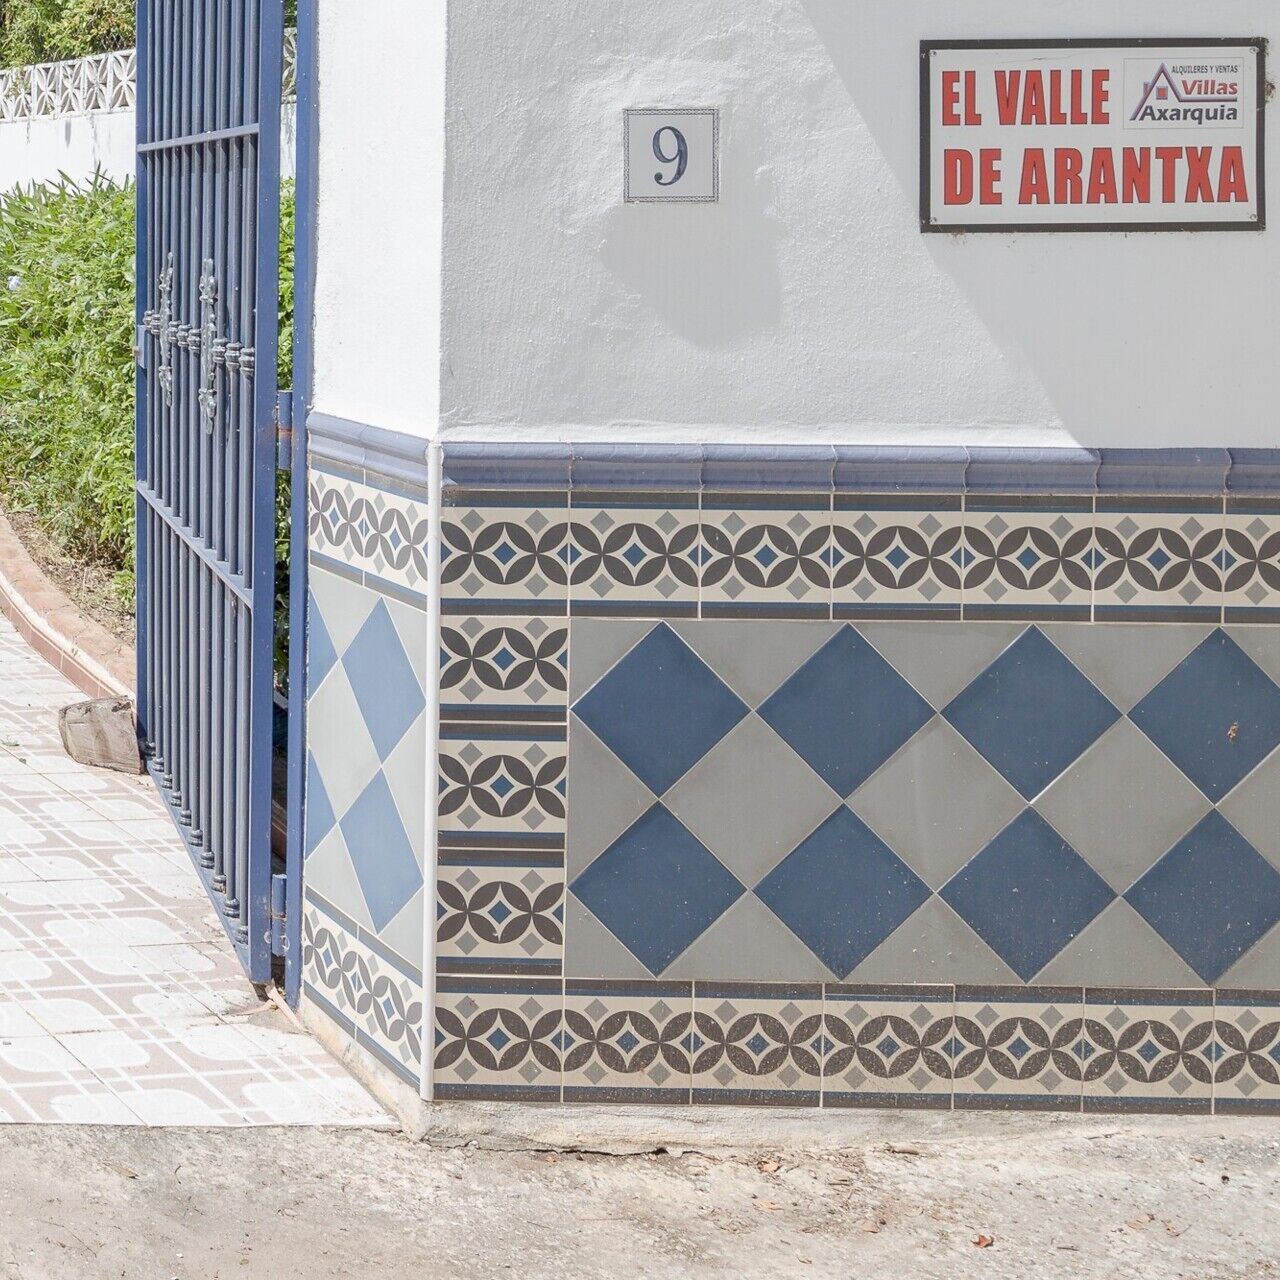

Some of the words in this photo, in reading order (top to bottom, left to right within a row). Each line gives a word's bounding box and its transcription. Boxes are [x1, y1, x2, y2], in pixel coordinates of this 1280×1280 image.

[1172, 66, 1208, 75] ALQUILERES
[1215, 65, 1238, 73] VENTAS
[1182, 80, 1238, 95] Villas
[942, 70, 982, 126] EL
[994, 69, 1110, 126] VALLE
[1139, 105, 1238, 125] Axarquia
[652, 126, 688, 186] 9
[944, 149, 1002, 205] DE
[1018, 146, 1248, 205] ARANTXA
